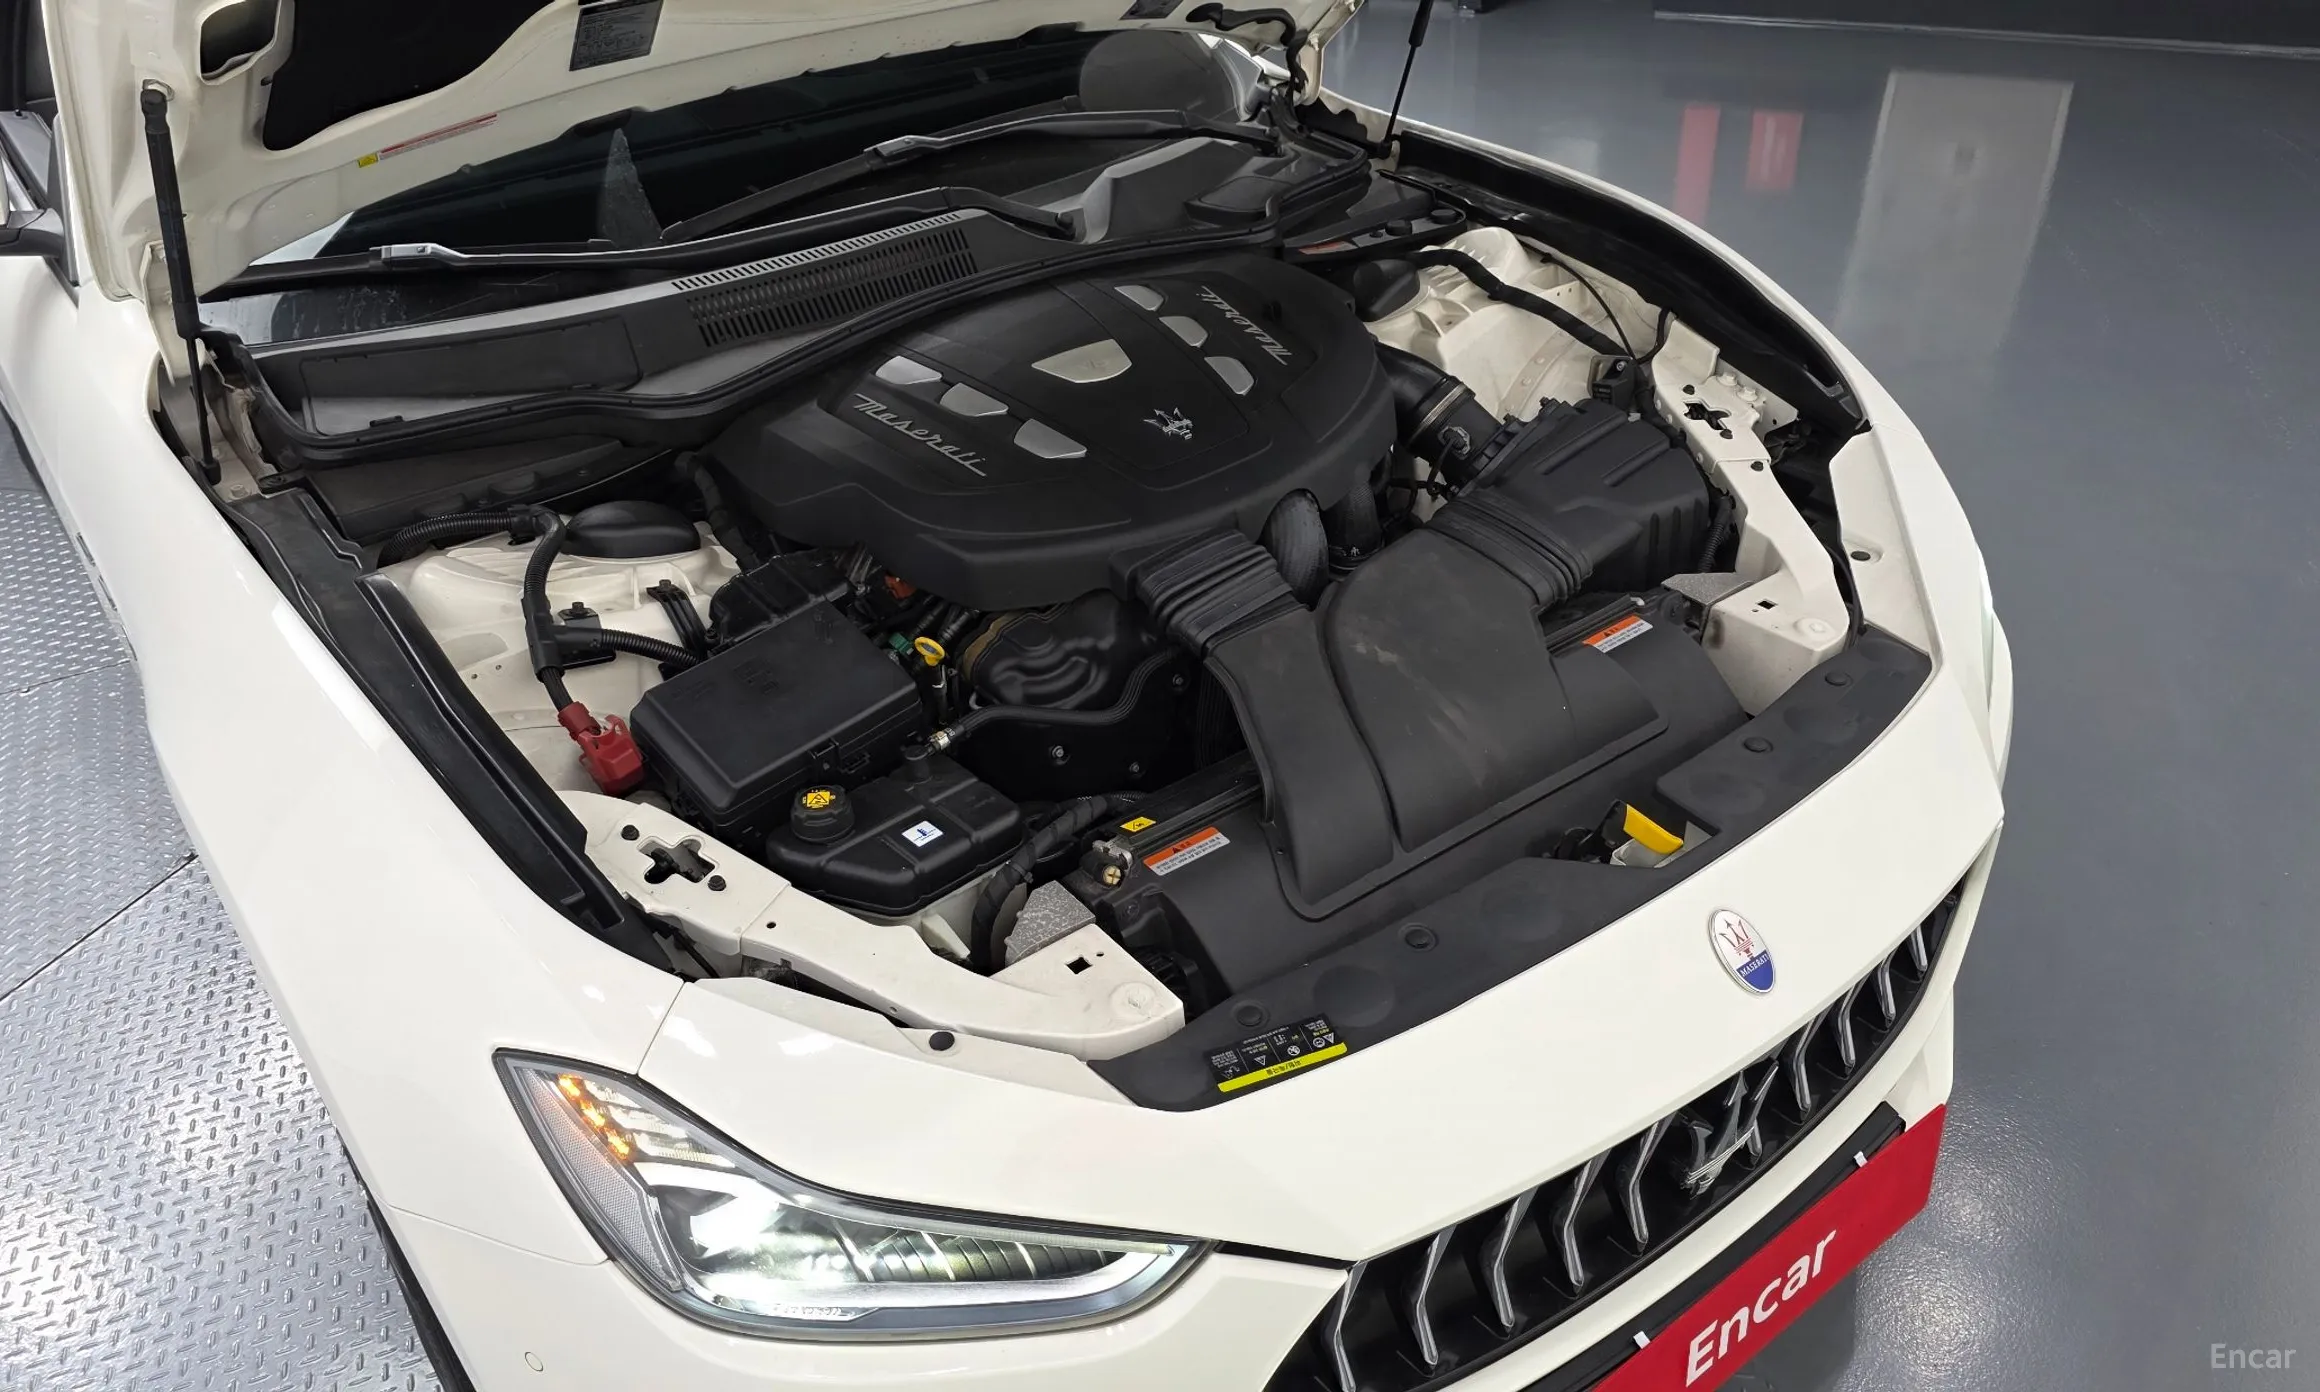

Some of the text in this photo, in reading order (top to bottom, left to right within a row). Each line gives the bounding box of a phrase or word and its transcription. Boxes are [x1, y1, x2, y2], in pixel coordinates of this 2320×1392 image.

[1196, 285, 1293, 366] Maserati
[853, 393, 987, 477] Maserati
[1739, 953, 1770, 977] MASERATI
[1685, 1229, 1838, 1388] Encar
